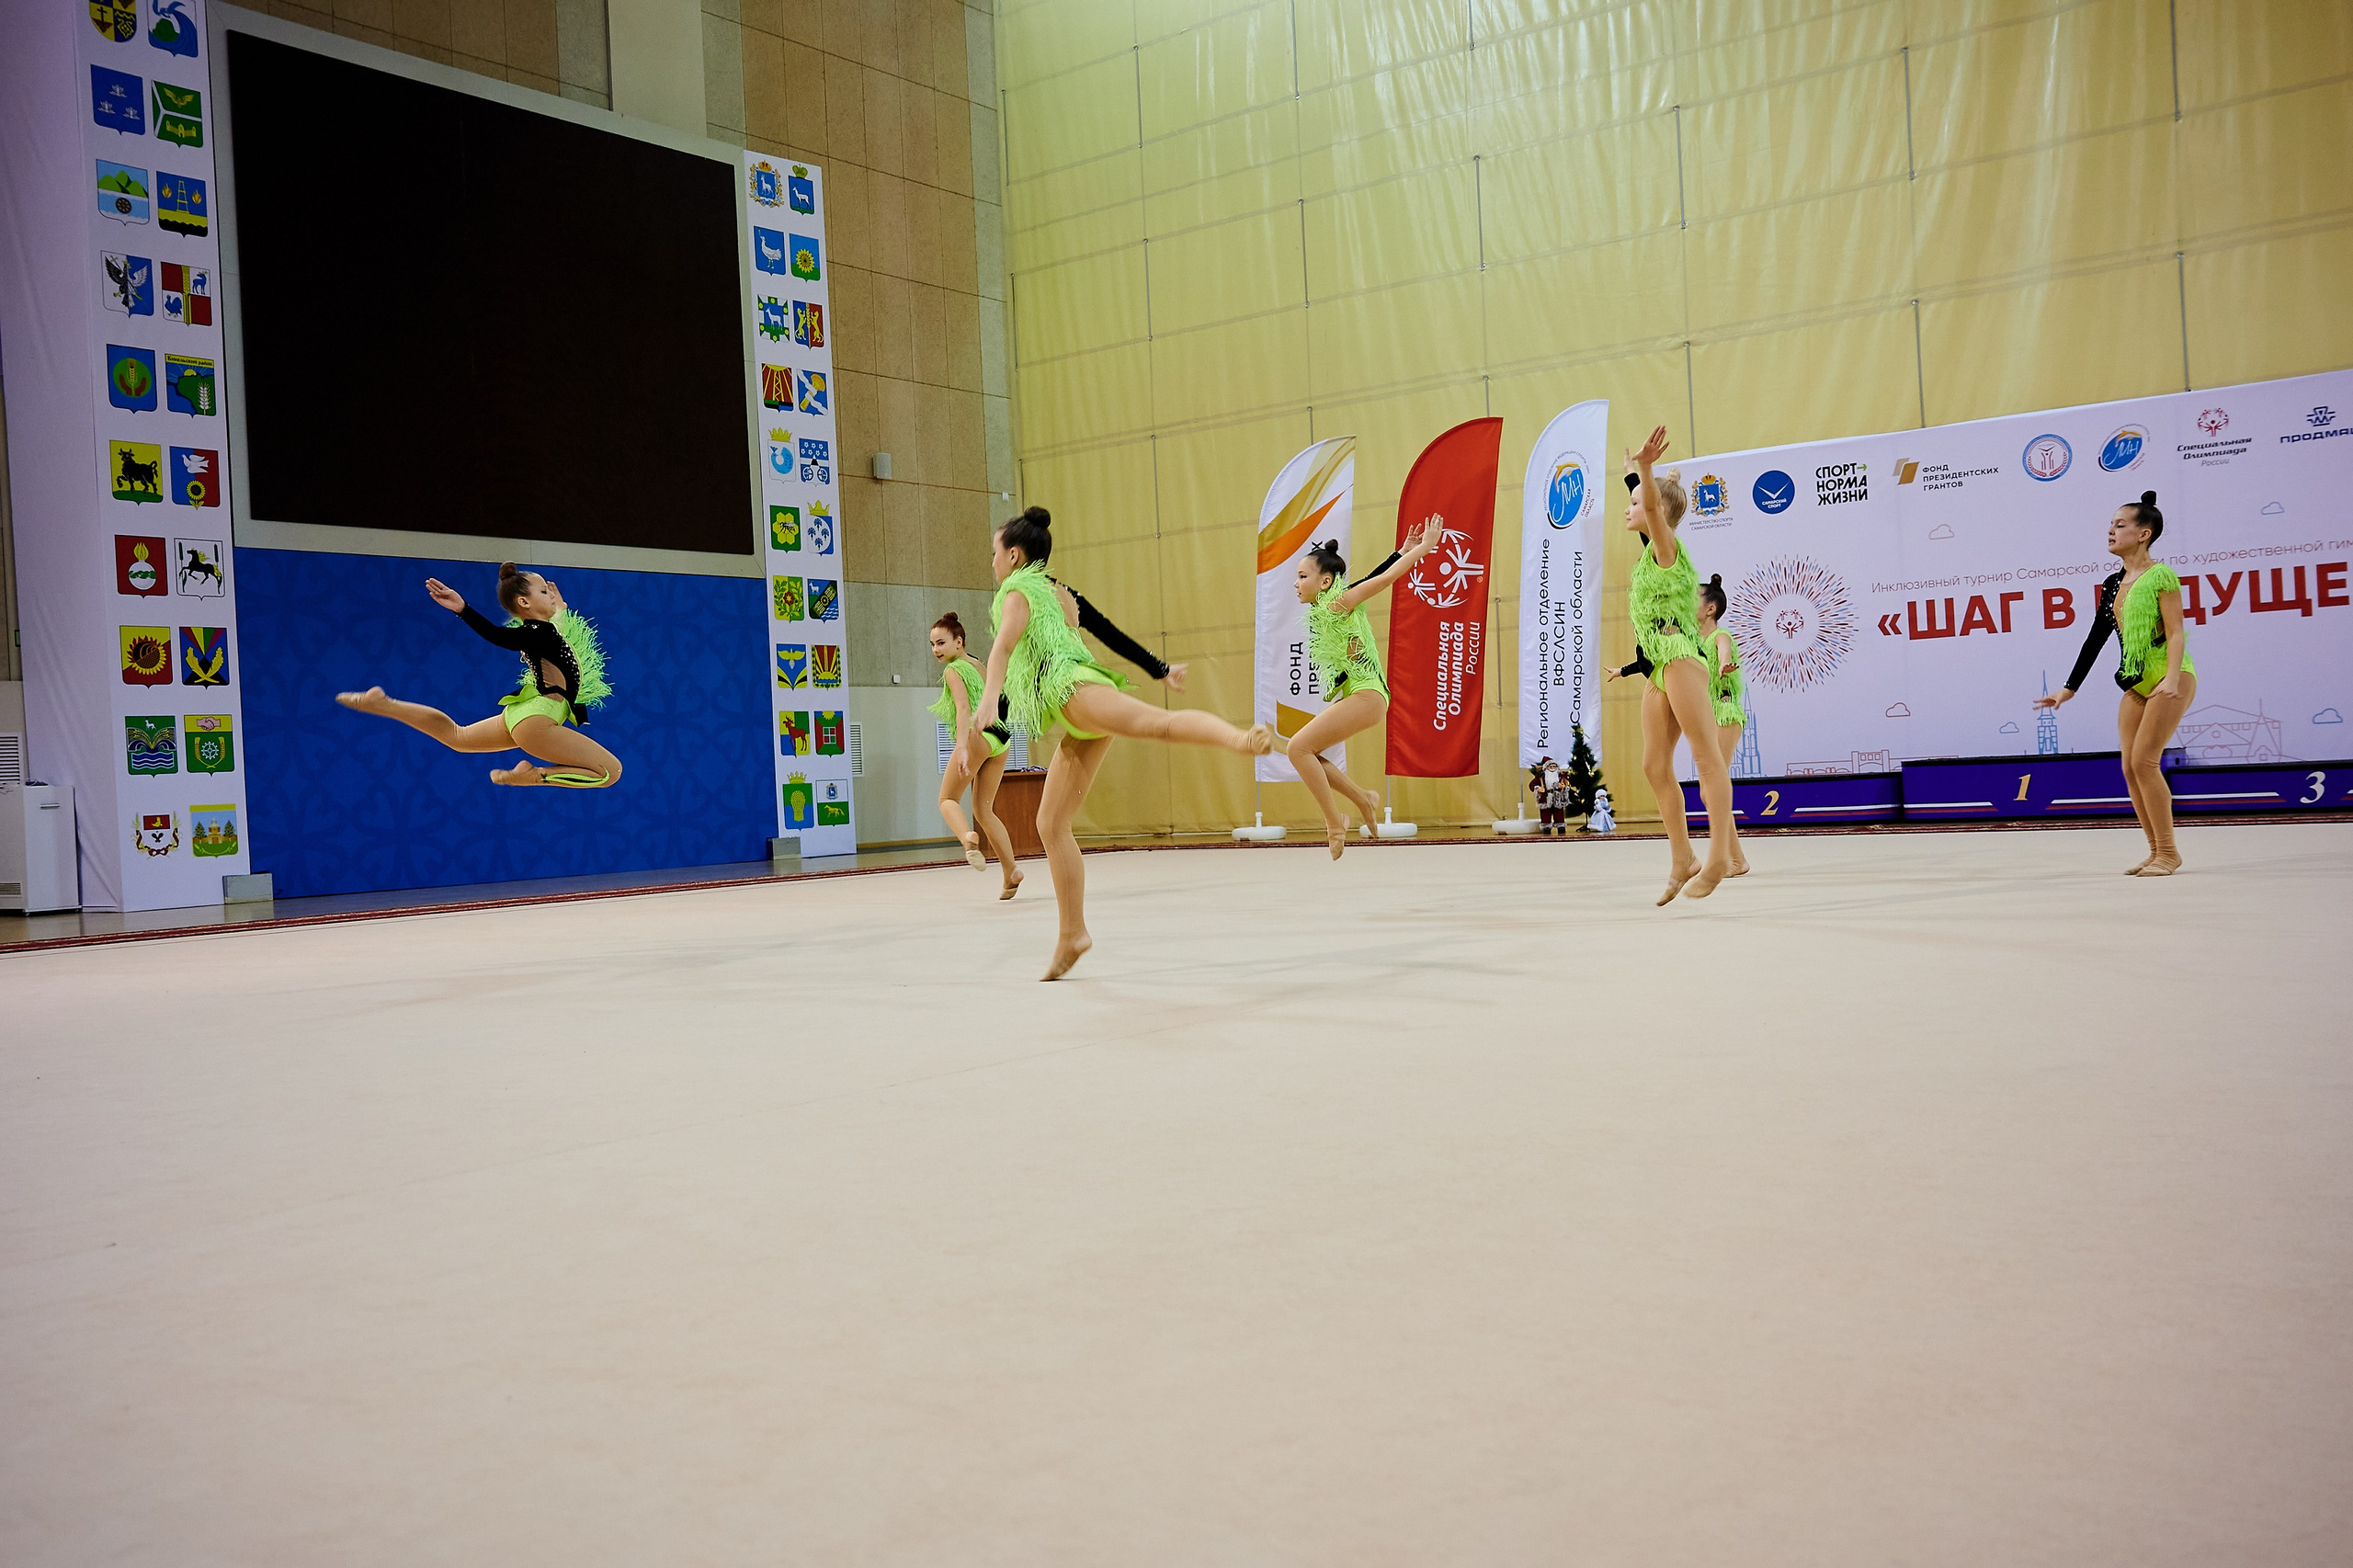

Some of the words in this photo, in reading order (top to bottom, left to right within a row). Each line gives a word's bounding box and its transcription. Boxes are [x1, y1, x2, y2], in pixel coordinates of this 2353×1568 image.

[2177, 437, 2253, 452] Специальная
[2280, 427, 2353, 444] ПРОДМА
[1922, 464, 1949, 473] ФОНД
[2183, 448, 2247, 460] Олимпиада
[2200, 459, 2230, 467] России
[1815, 462, 1858, 480] СПОРТ
[1816, 474, 1868, 493] НОРМА
[1923, 467, 1999, 483] ПРЕЗИДЕНТСКИХ
[1817, 487, 1869, 506] ЖИЗНИ
[1923, 481, 1963, 492] ГРАНТОВ
[1871, 575, 1961, 594] Инклюзивный
[1963, 571, 2013, 587] турнир
[2017, 562, 2099, 580] Самарской
[2170, 555, 2188, 565] по
[2193, 540, 2324, 565] художественной
[1539, 539, 1551, 626] отделение
[1570, 551, 1583, 619] области
[1877, 591, 2024, 641] «ШАГ
[2042, 587, 2075, 631] В
[1465, 621, 1481, 675] России
[1553, 601, 1566, 686] ВФСЛСИН
[1290, 642, 1303, 696] ФОНД
[1433, 620, 1450, 731] Специальная
[1448, 621, 1464, 716] Олимпиада
[1570, 625, 1586, 724] Самарской
[1537, 631, 1549, 748] Региональное
[2014, 774, 2033, 801] 1
[2300, 770, 2325, 804] 3
[1759, 790, 1781, 816] 2
